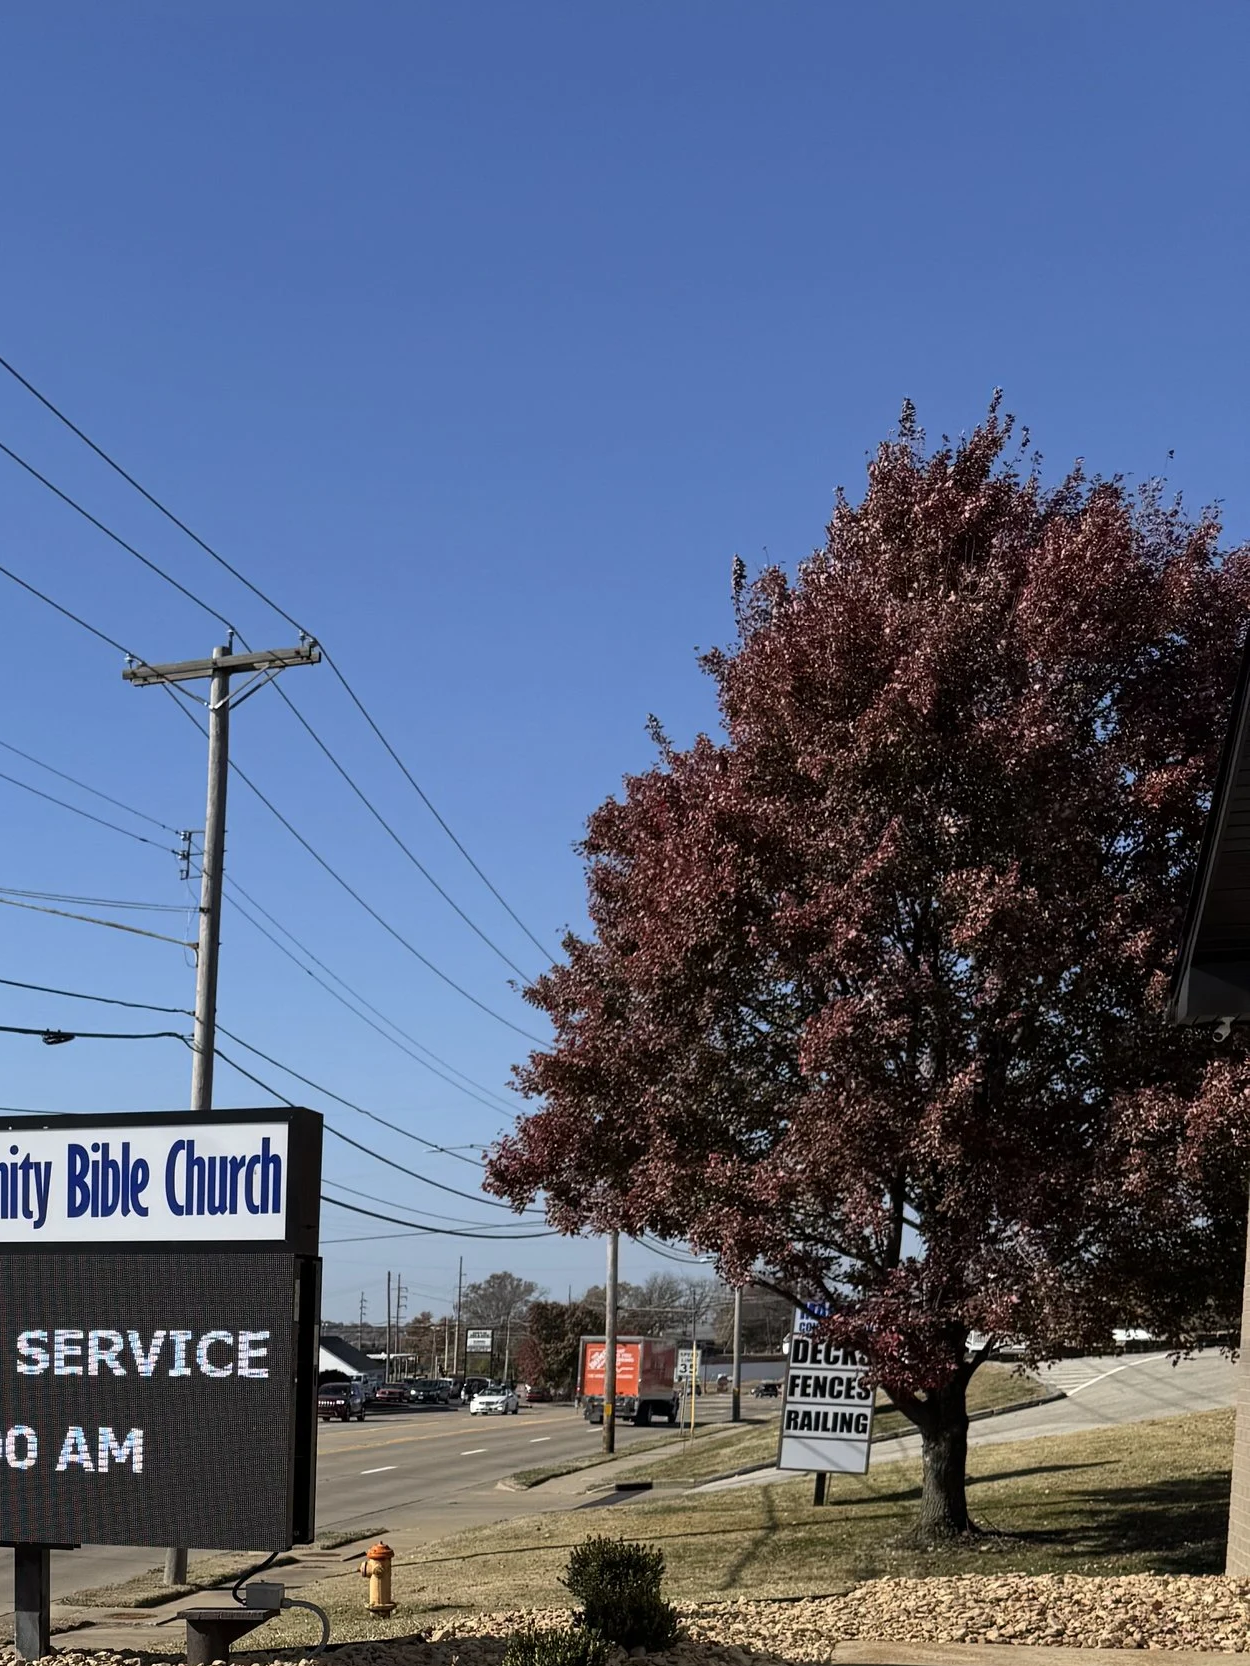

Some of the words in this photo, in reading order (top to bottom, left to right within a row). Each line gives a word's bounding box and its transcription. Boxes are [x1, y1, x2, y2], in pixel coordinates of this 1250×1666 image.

[67, 1142, 149, 1218] Bible
[165, 1137, 282, 1216] Church
[16, 1329, 270, 1378] SERVICE
[788, 1374, 871, 1401] FENCES
[785, 1410, 869, 1434] RAILING
[55, 1426, 143, 1473] AM
